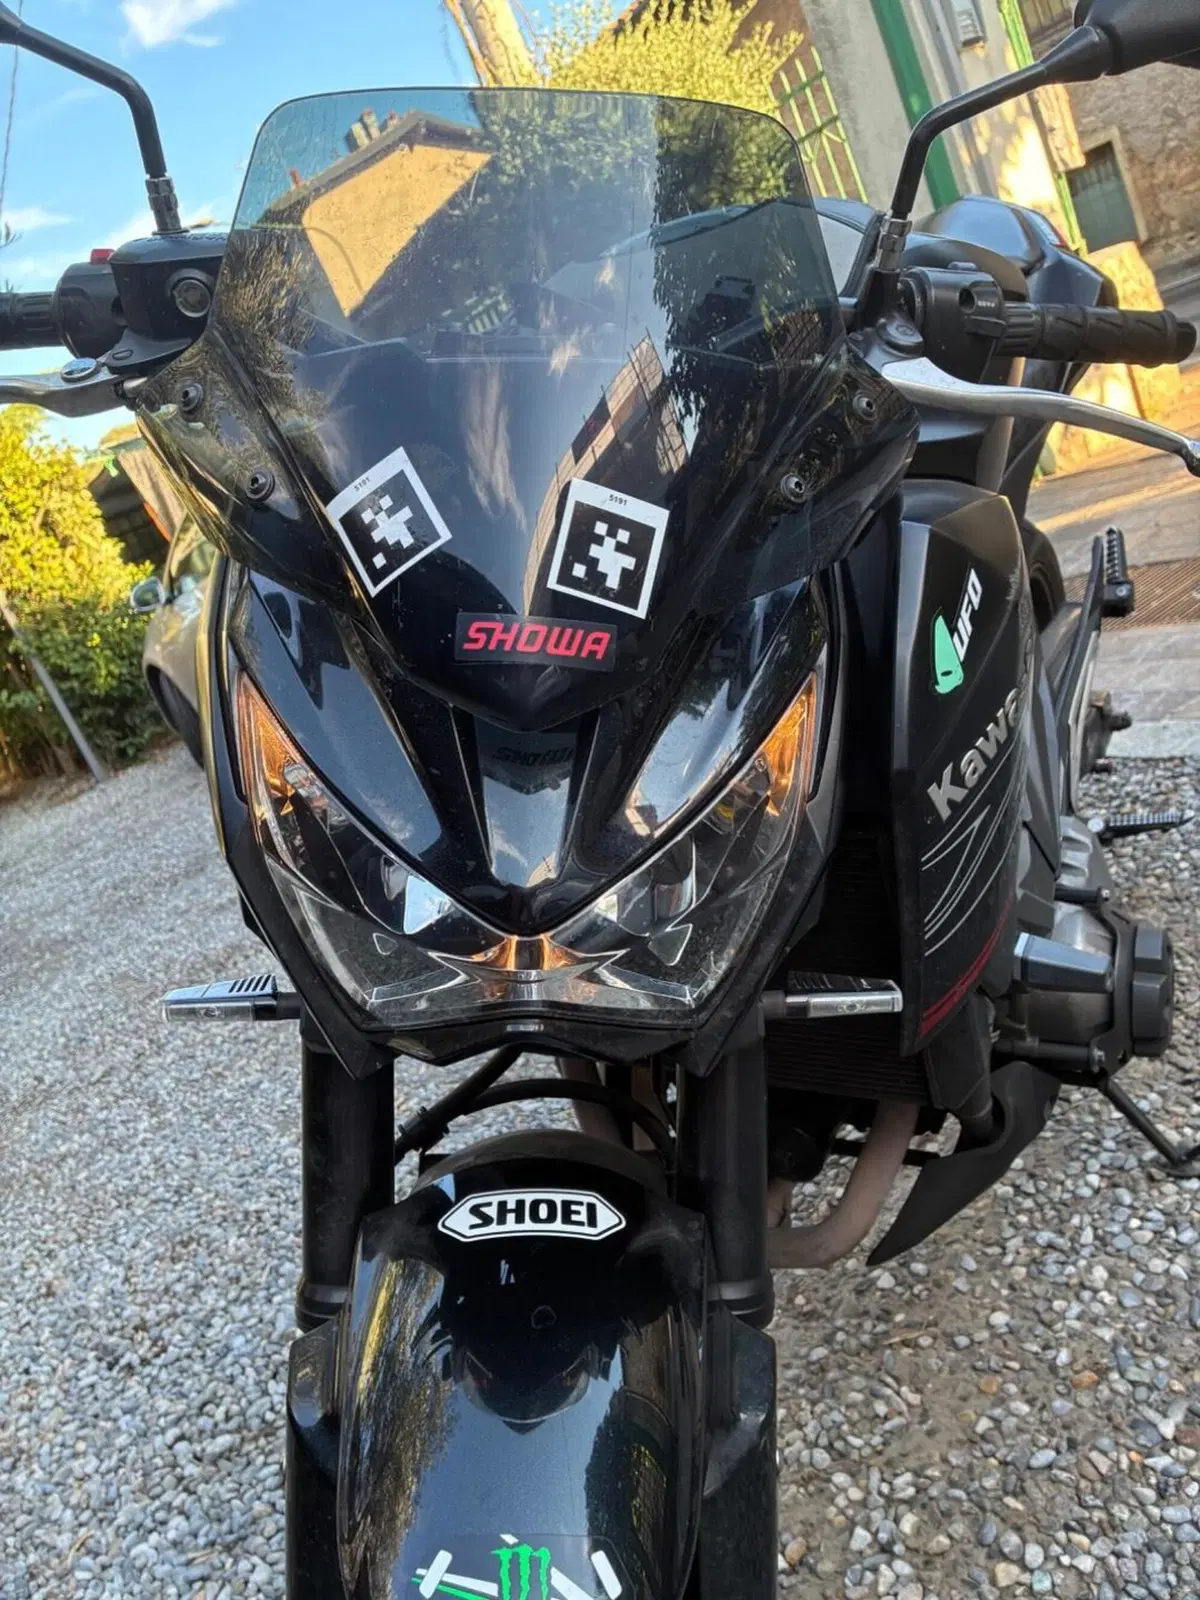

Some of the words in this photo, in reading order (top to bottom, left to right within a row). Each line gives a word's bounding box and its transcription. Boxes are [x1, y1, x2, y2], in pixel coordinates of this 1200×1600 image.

[609, 494, 627, 506] 5191
[953, 567, 983, 663] UFO
[463, 621, 610, 659] SHOWA
[468, 1198, 598, 1231] SHOEI
